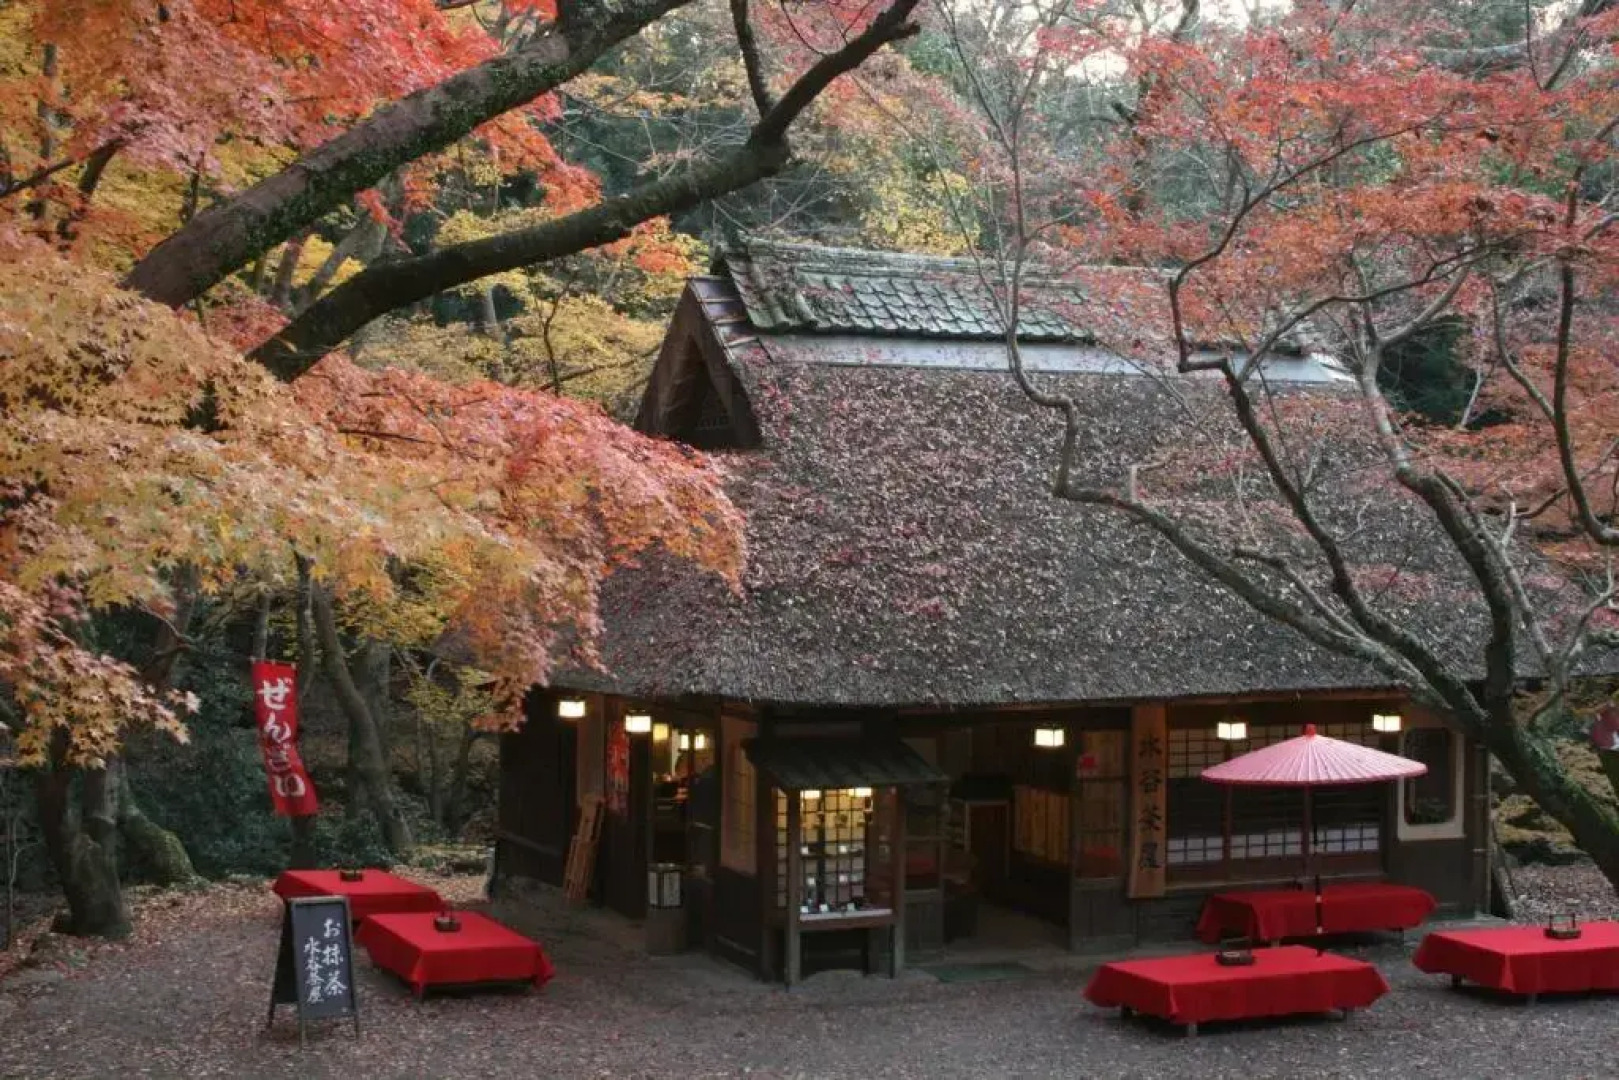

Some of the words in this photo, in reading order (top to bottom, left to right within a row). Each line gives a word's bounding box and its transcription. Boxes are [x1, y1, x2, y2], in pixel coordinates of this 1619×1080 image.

[1138, 731, 1164, 873] 水谷茶屋
[303, 935, 325, 1006] 水谷茶屋
[321, 918, 348, 996] お抹茶
